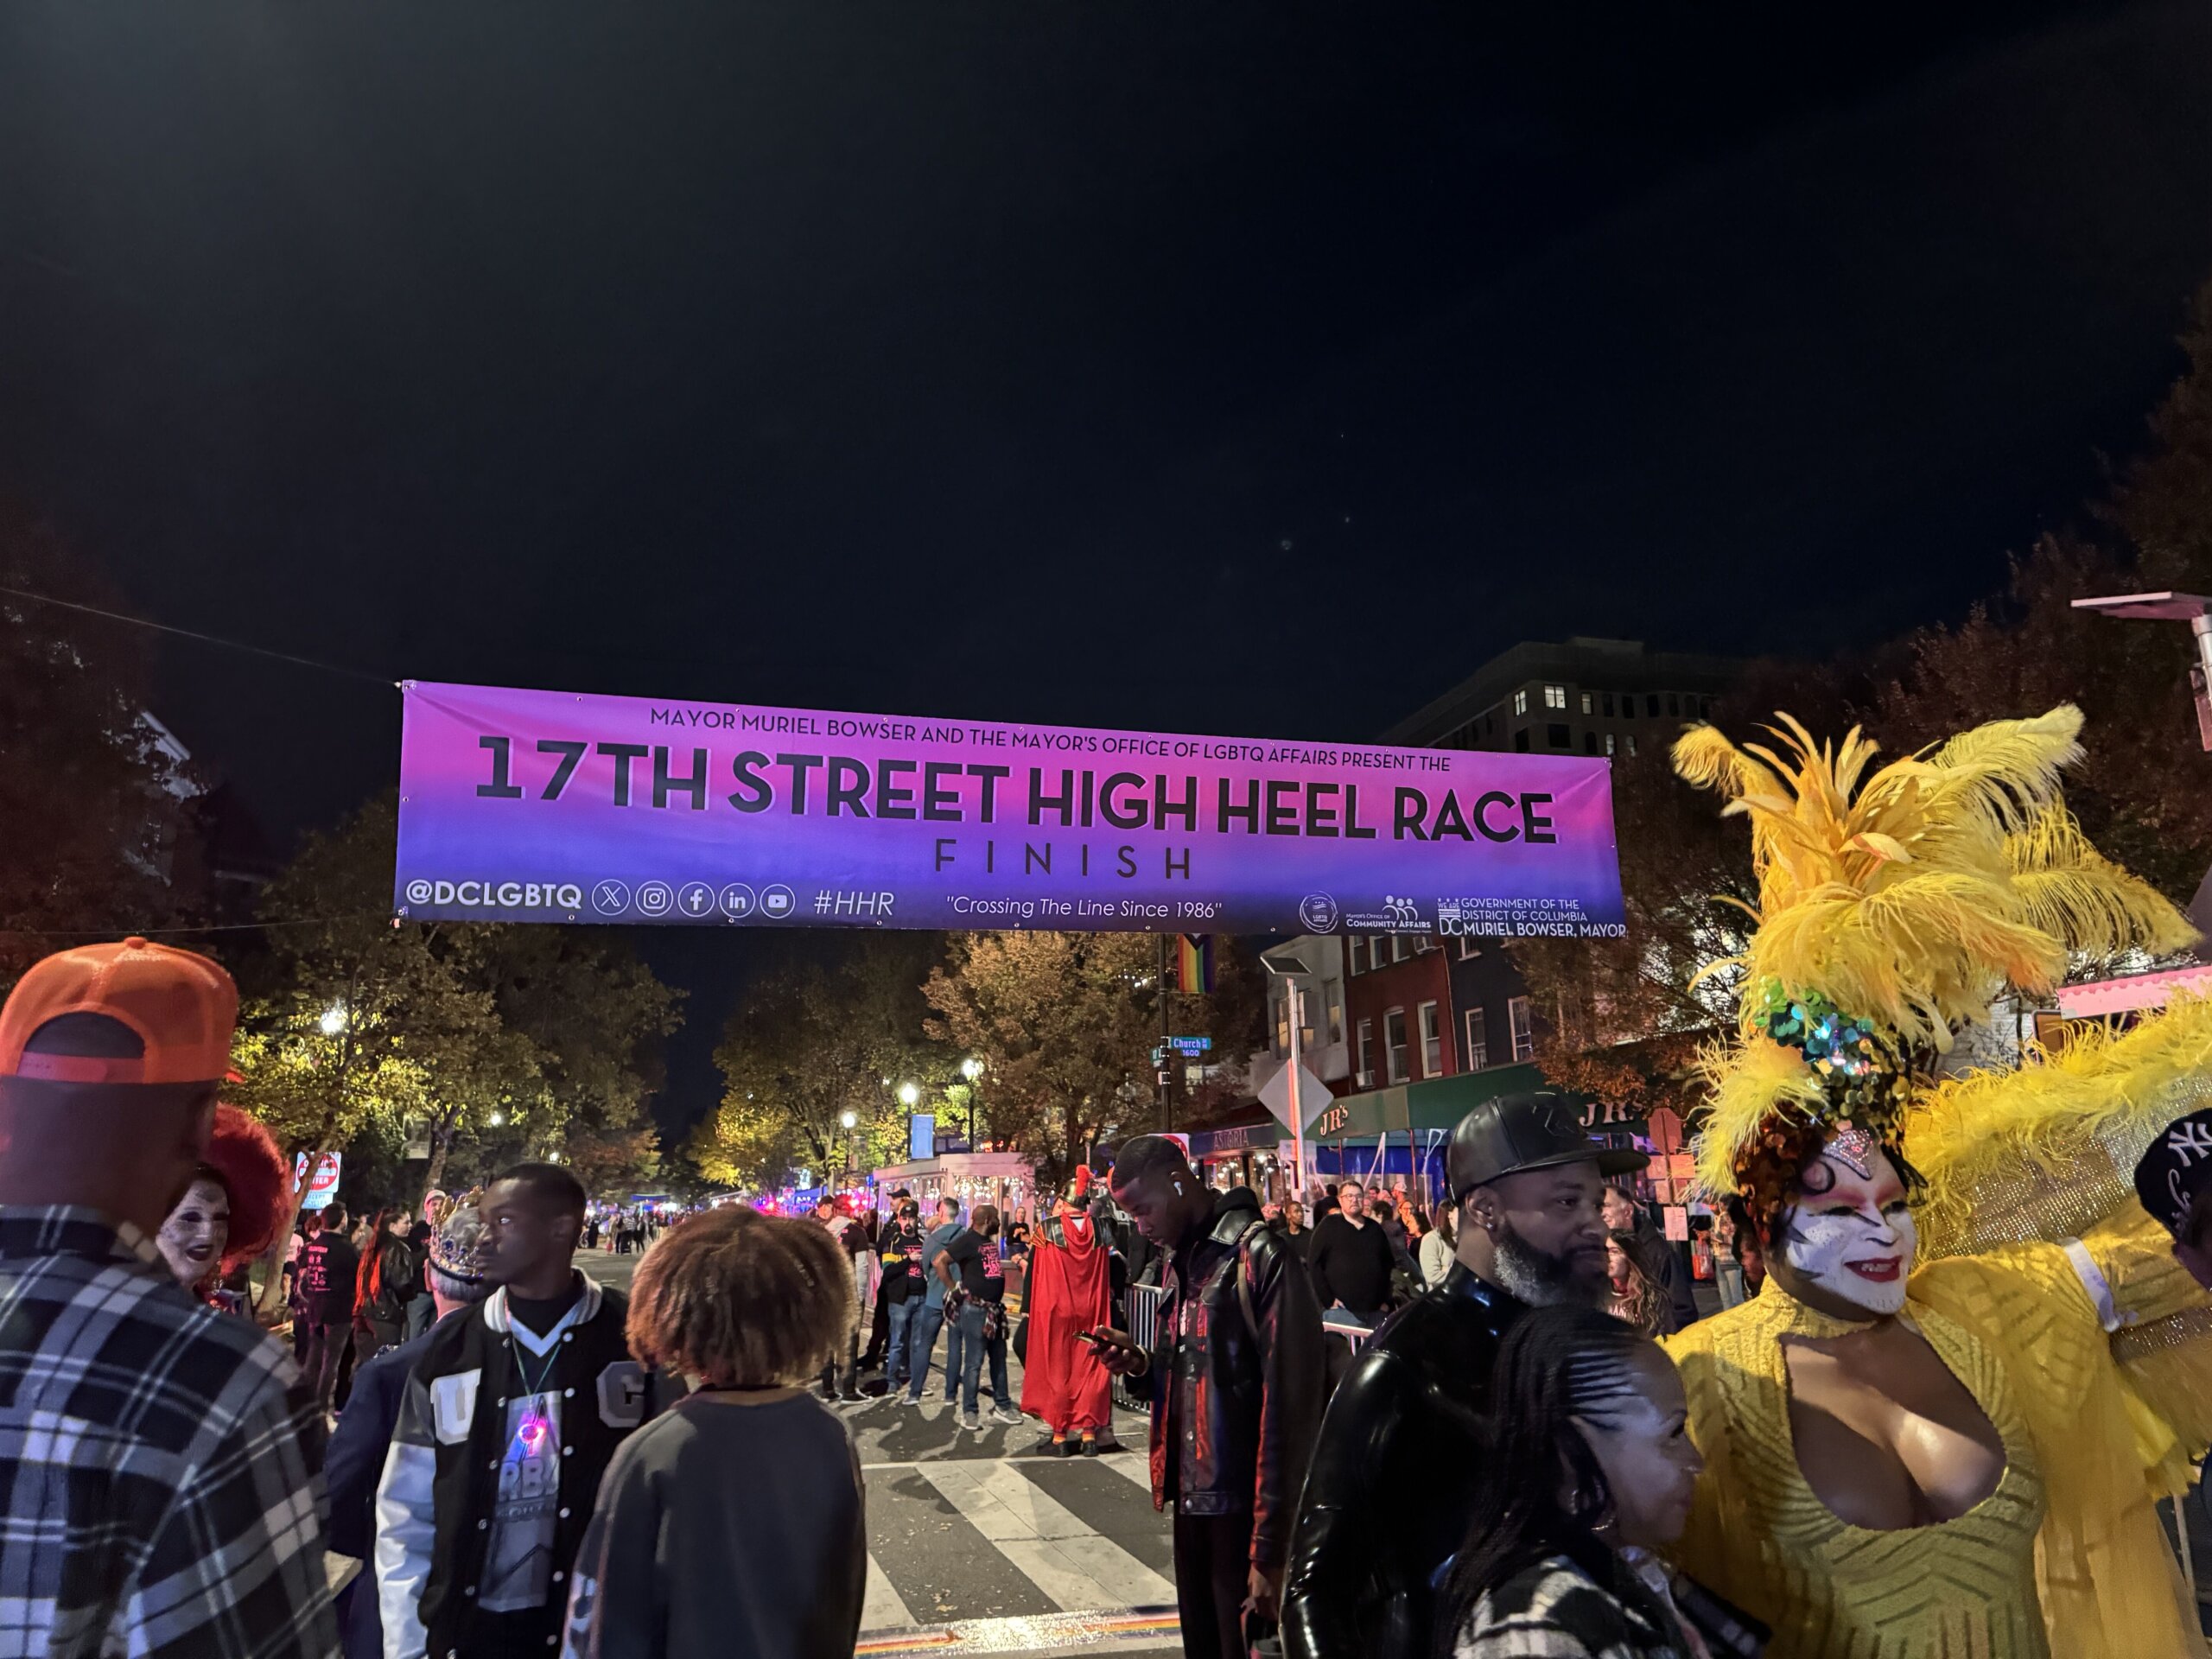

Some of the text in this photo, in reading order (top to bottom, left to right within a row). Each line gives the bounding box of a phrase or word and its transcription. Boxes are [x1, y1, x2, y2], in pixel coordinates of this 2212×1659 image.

[651, 708, 1451, 772] MAYOR MURIEL BOWSER AND THE MAYOR'S OFFICE OF LGBTQ AFFAIRS PRESENT THE
[476, 734, 1559, 844] 17TH STREET HIGH HEEL RACE
[935, 838, 1191, 880] FINISH
[405, 878, 582, 910] @DCLGBTQ
[814, 889, 894, 917] #HHR
[1461, 898, 1580, 910] GOVERNMENT OF THE
[947, 896, 1222, 918] "Crossing The Line Since 1986"
[1462, 910, 1588, 922] DISTRICT OF COLUMBIA
[1346, 918, 1431, 928] COMMUNITY AFFAIRS
[1439, 918, 1463, 935] DC
[1464, 922, 1625, 938] MURIEL BOWSER, MAYOR
[1173, 1038, 1201, 1048] Church
[1213, 1130, 1249, 1150] ASTORIA
